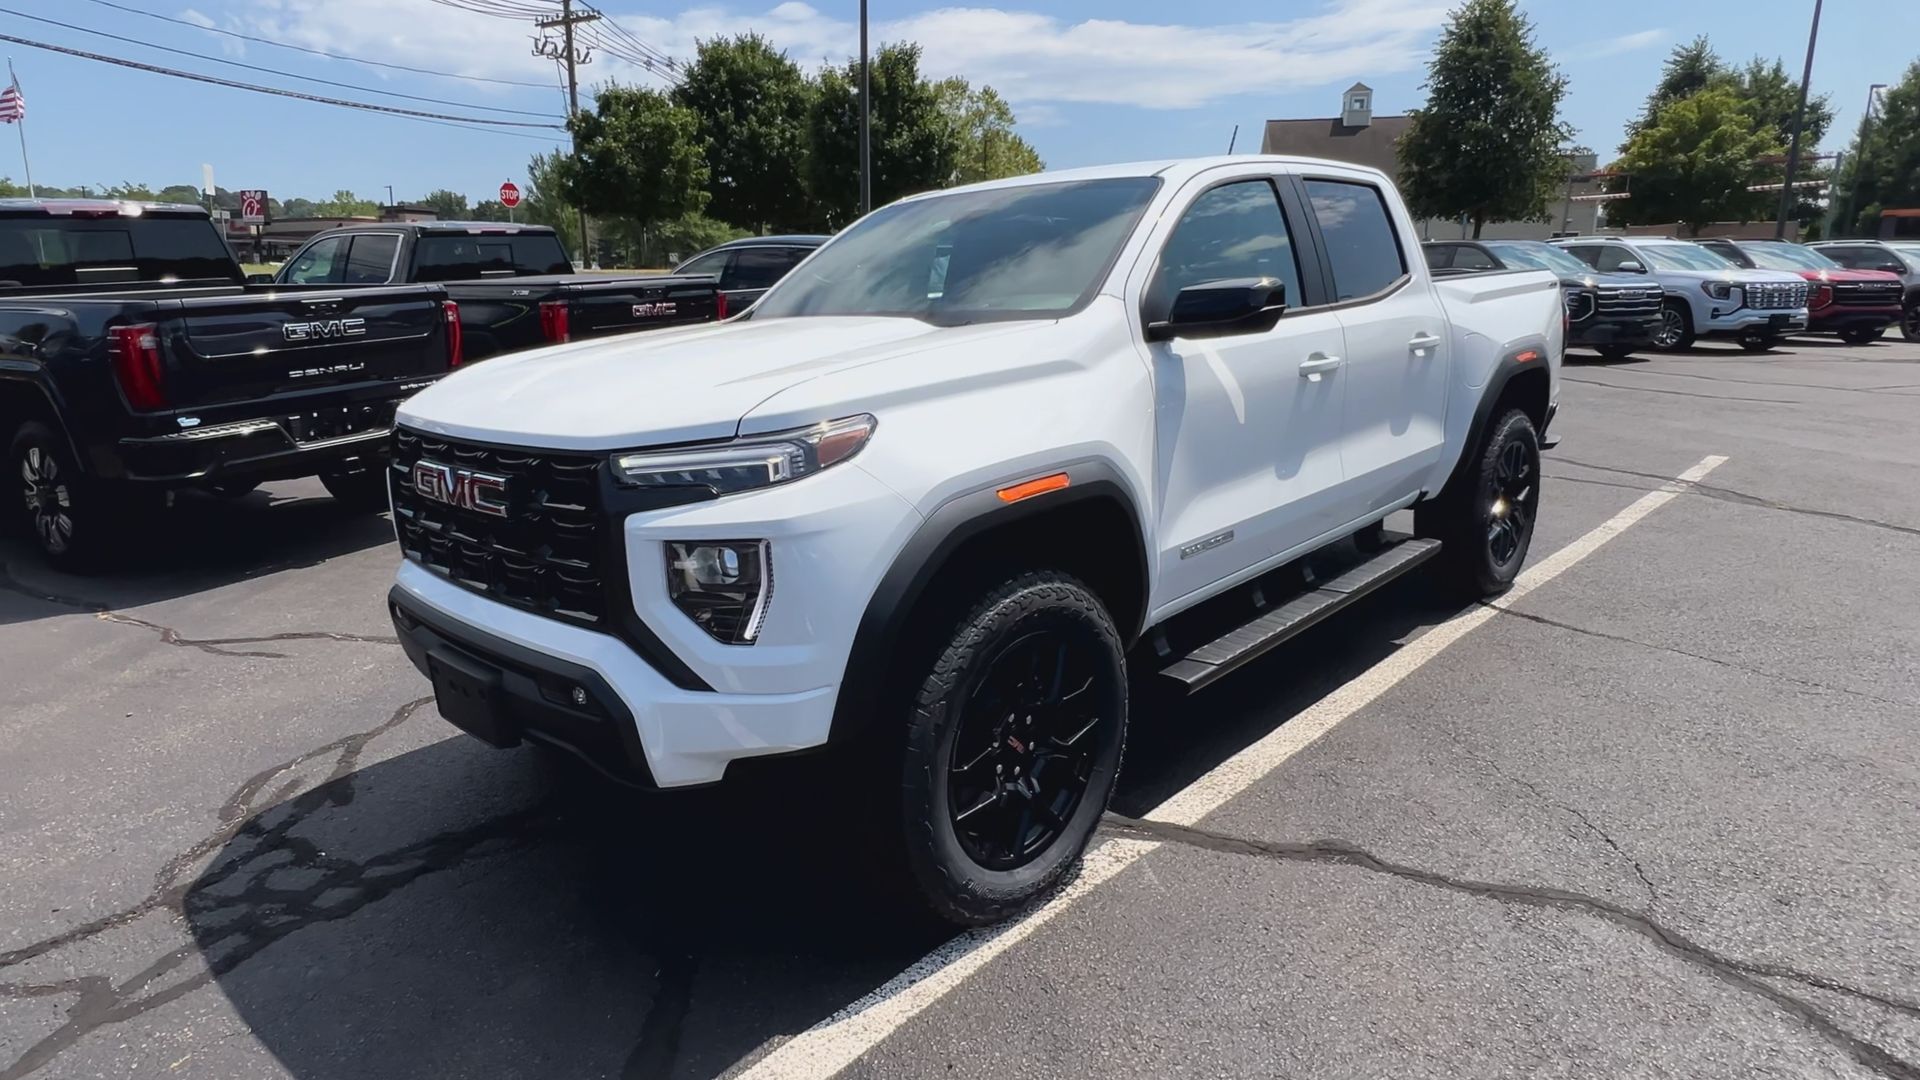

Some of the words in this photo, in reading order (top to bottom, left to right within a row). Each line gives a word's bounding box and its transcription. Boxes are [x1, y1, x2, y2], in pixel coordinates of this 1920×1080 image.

[501, 189, 519, 200] STOP
[632, 302, 677, 318] GMC
[282, 318, 366, 342] GMC
[289, 362, 365, 378] DENALI
[413, 460, 508, 518] GMC
